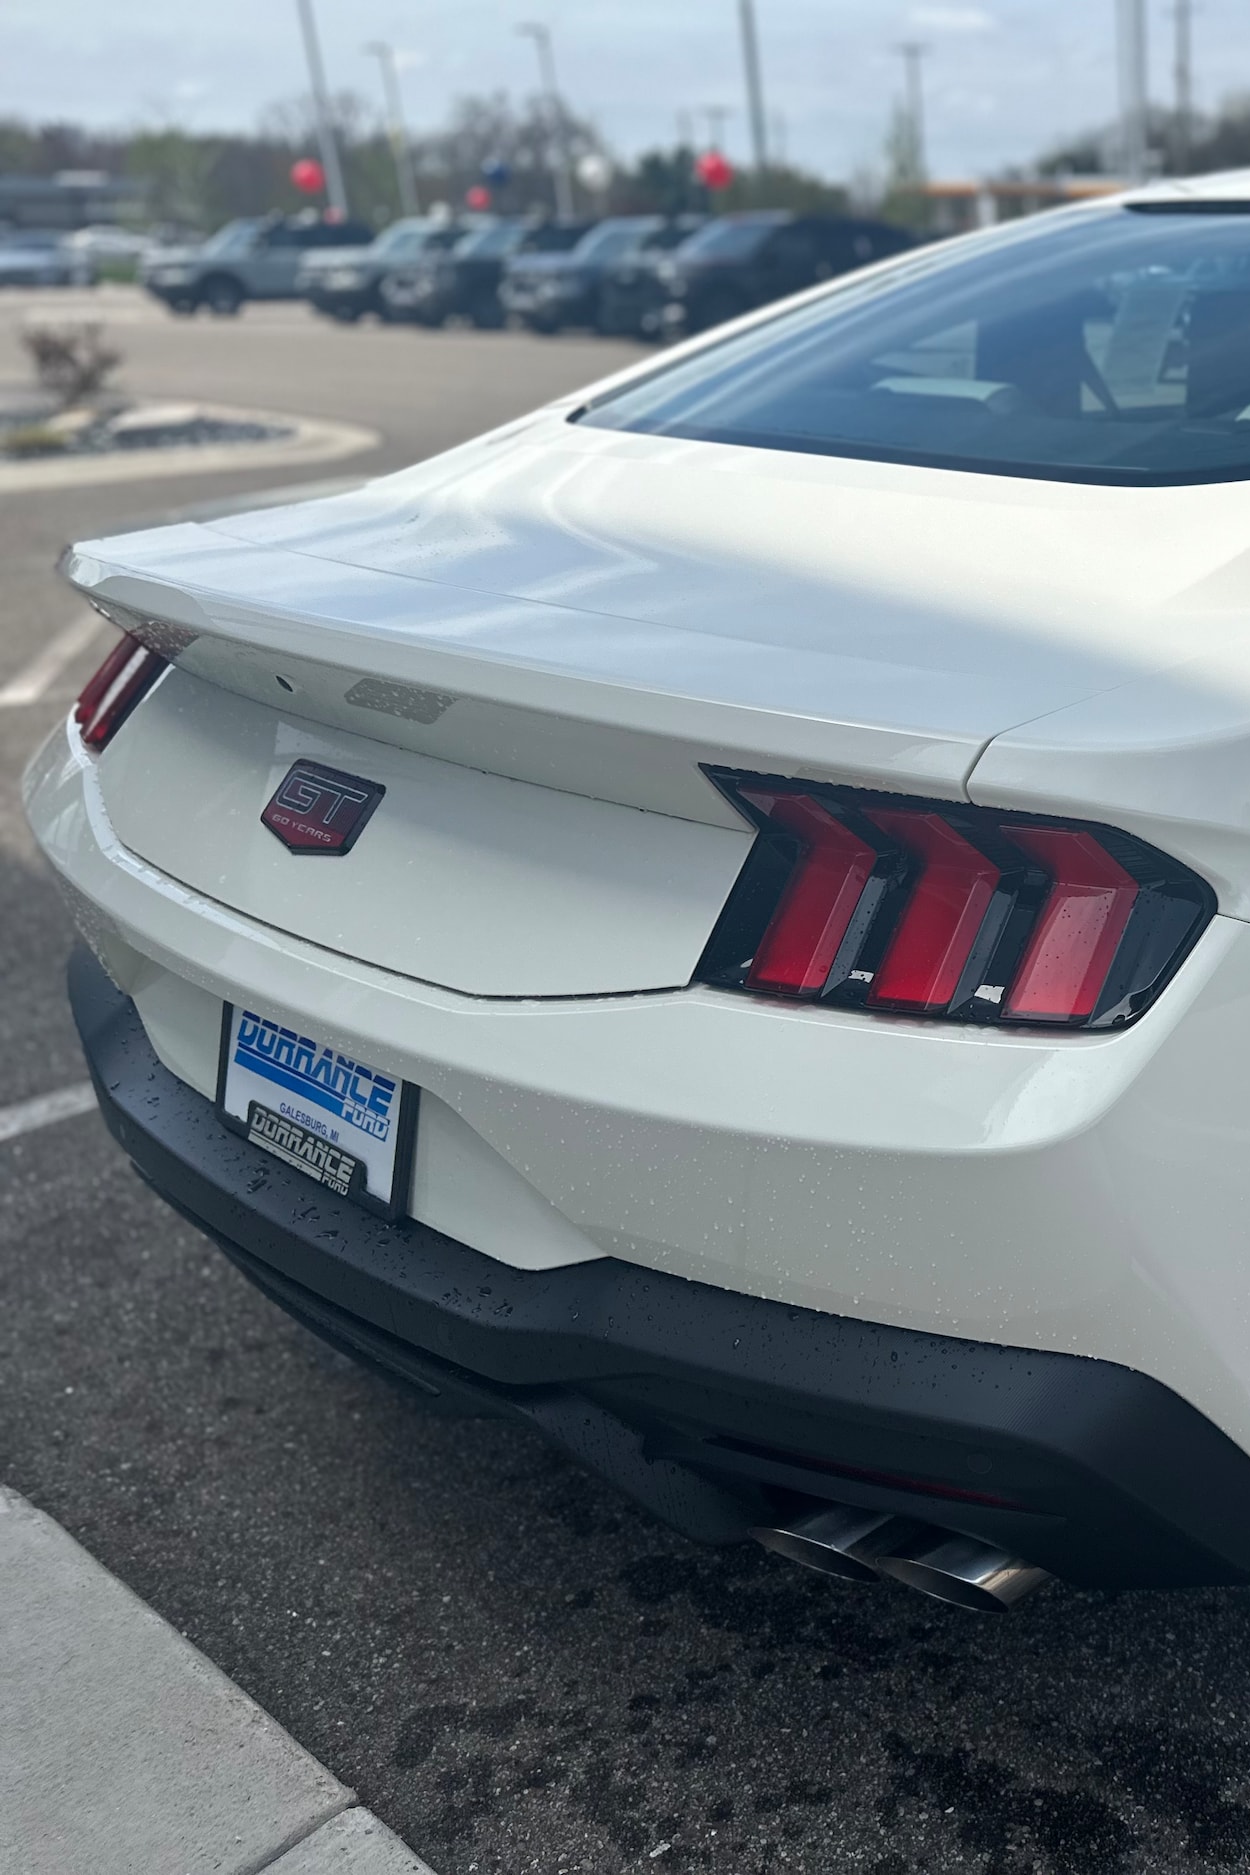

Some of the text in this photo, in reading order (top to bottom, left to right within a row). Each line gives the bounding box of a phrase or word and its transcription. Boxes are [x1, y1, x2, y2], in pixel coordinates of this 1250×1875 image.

[272, 814, 332, 843] 60 YEARS
[279, 1102, 340, 1143] GALESBURG, MI
[341, 1097, 389, 1140] FORD
[321, 1172, 349, 1196] FORD
